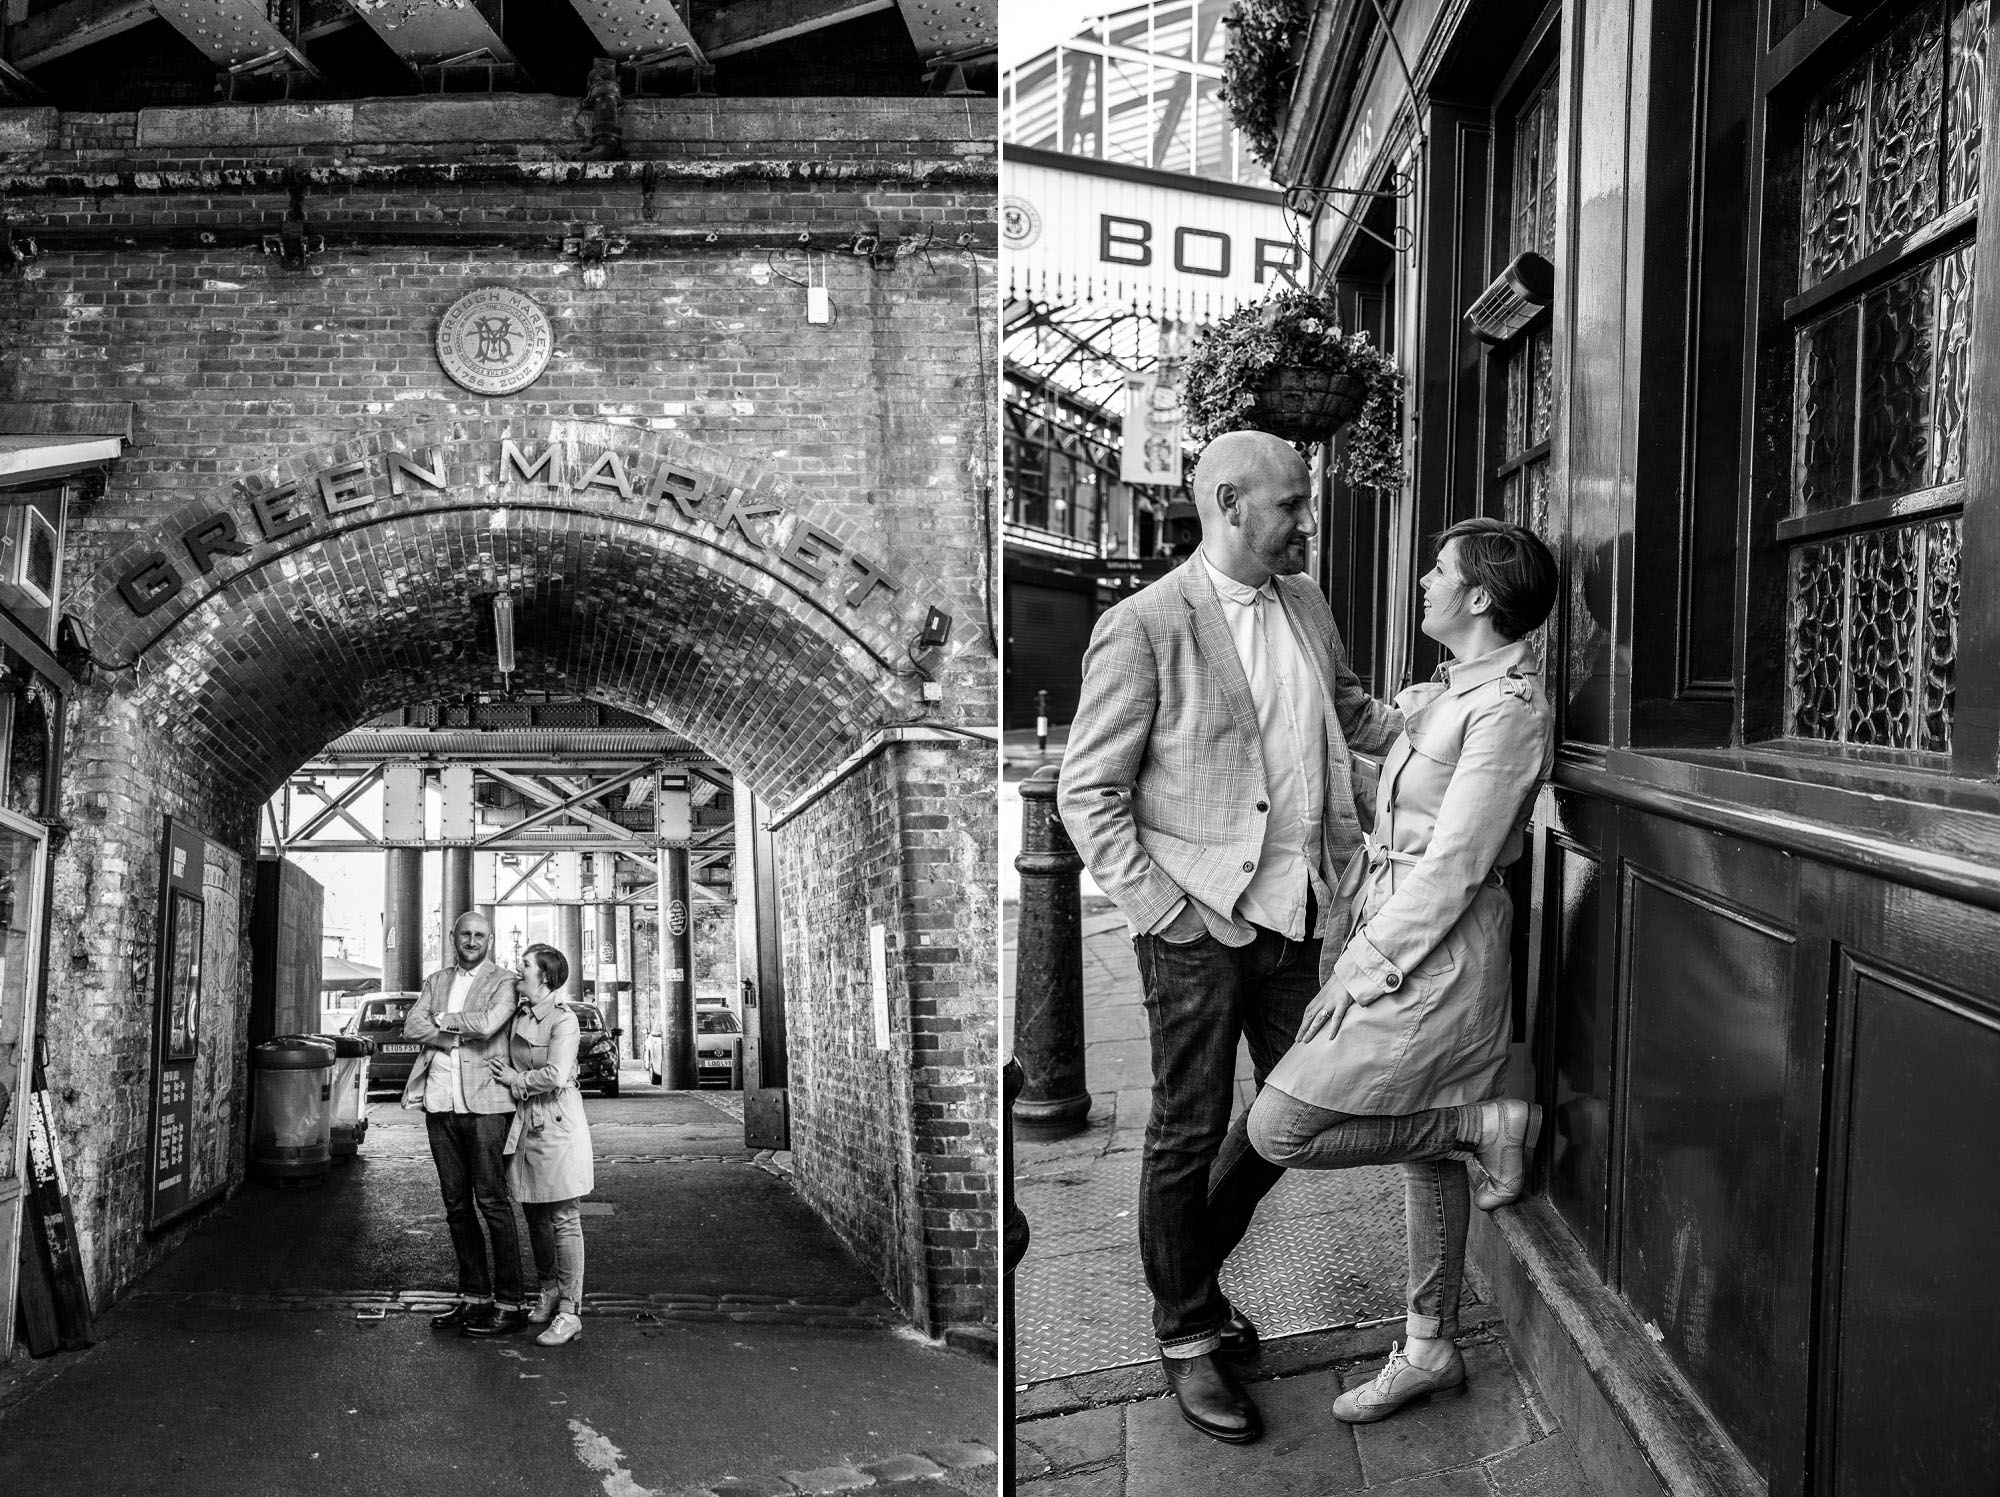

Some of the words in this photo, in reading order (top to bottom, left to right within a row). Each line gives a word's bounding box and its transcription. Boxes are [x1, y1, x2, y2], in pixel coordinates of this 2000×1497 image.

[442, 292, 500, 355] BOROUGH
[509, 296, 546, 358] MARKET
[456, 366, 484, 386] 1756
[500, 367, 532, 388] 2002
[116, 445, 446, 617] GREEN
[500, 439, 900, 606] MARKET
